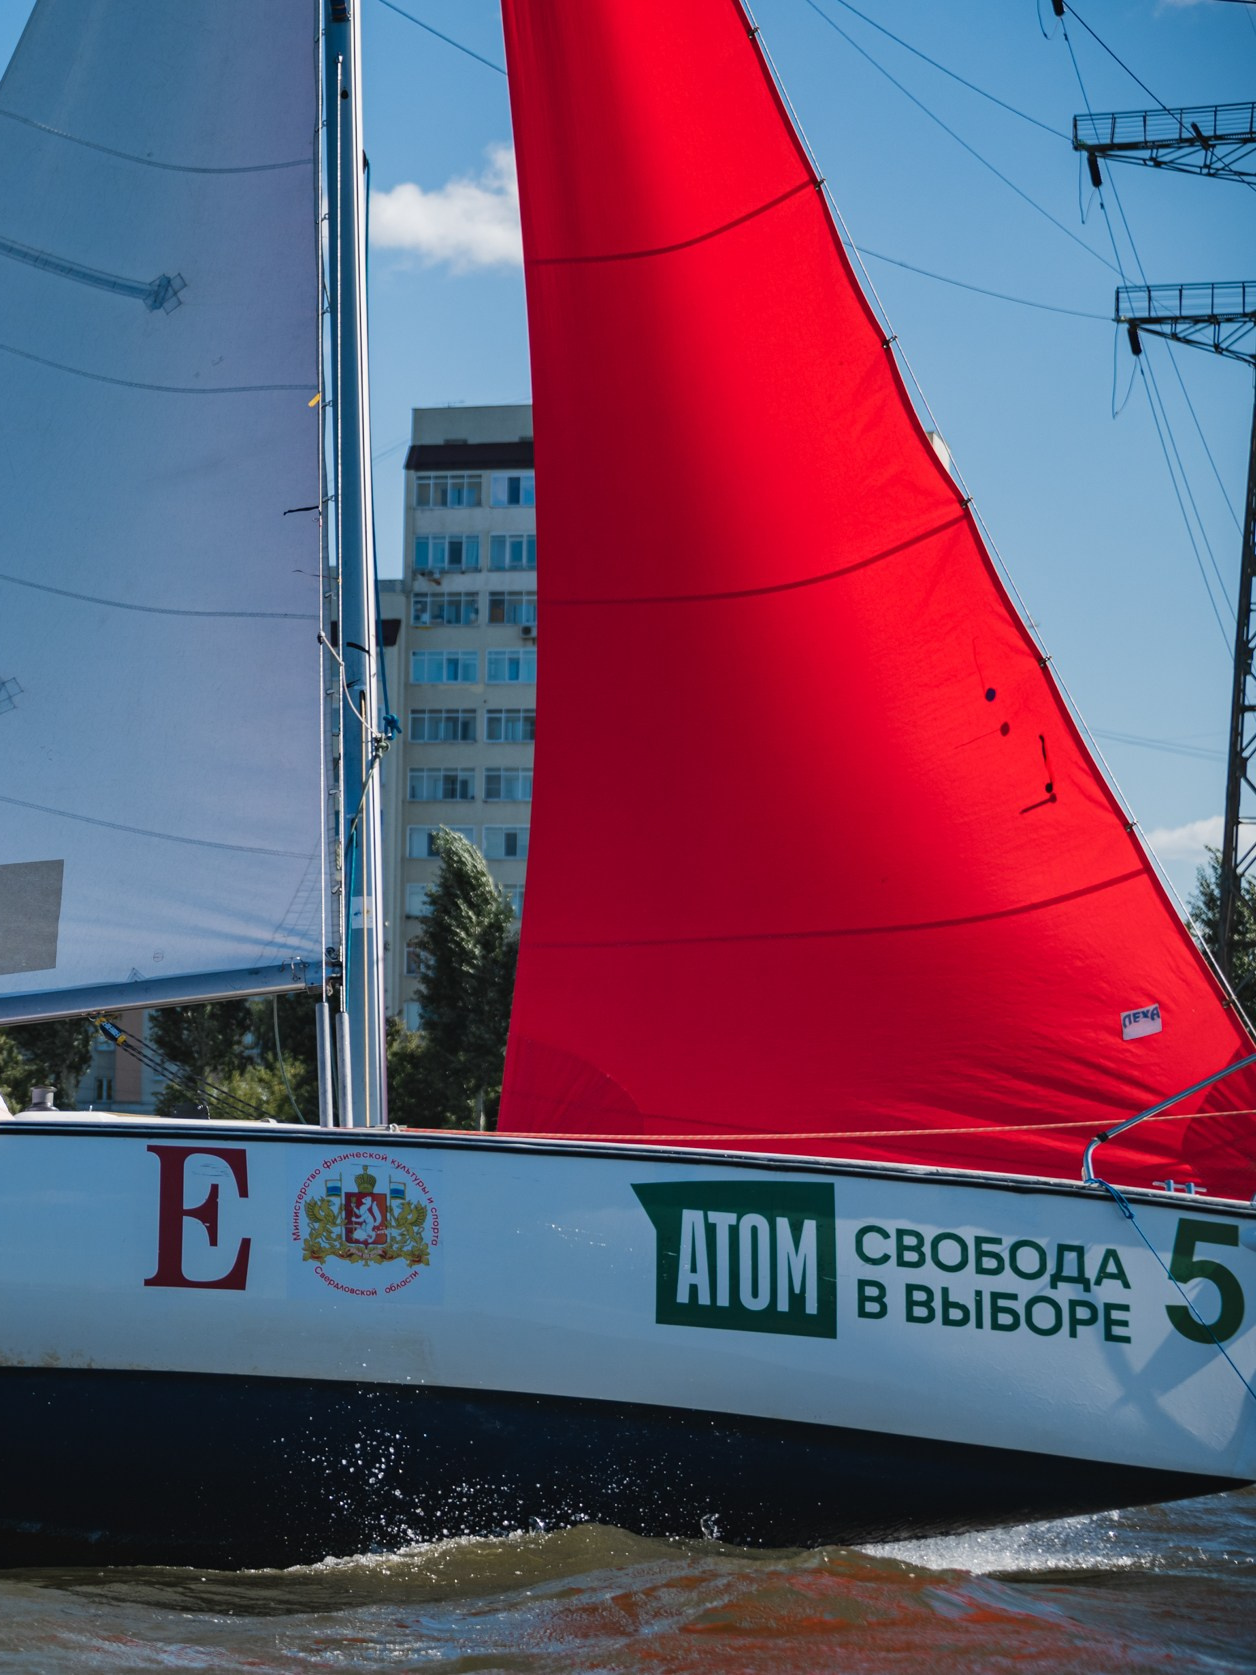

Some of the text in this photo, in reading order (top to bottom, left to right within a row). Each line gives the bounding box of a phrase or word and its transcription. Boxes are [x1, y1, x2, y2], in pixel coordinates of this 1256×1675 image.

[293, 1151, 440, 1246] Министерство физической культуры и спорта
[314, 1265, 420, 1297] Свердловской области
[676, 1208, 818, 1315] АТОМ
[855, 1224, 1131, 1292] СВОБОДА
[1164, 1217, 1245, 1345] 5
[856, 1279, 1131, 1344] В ВЫБОРЕ
